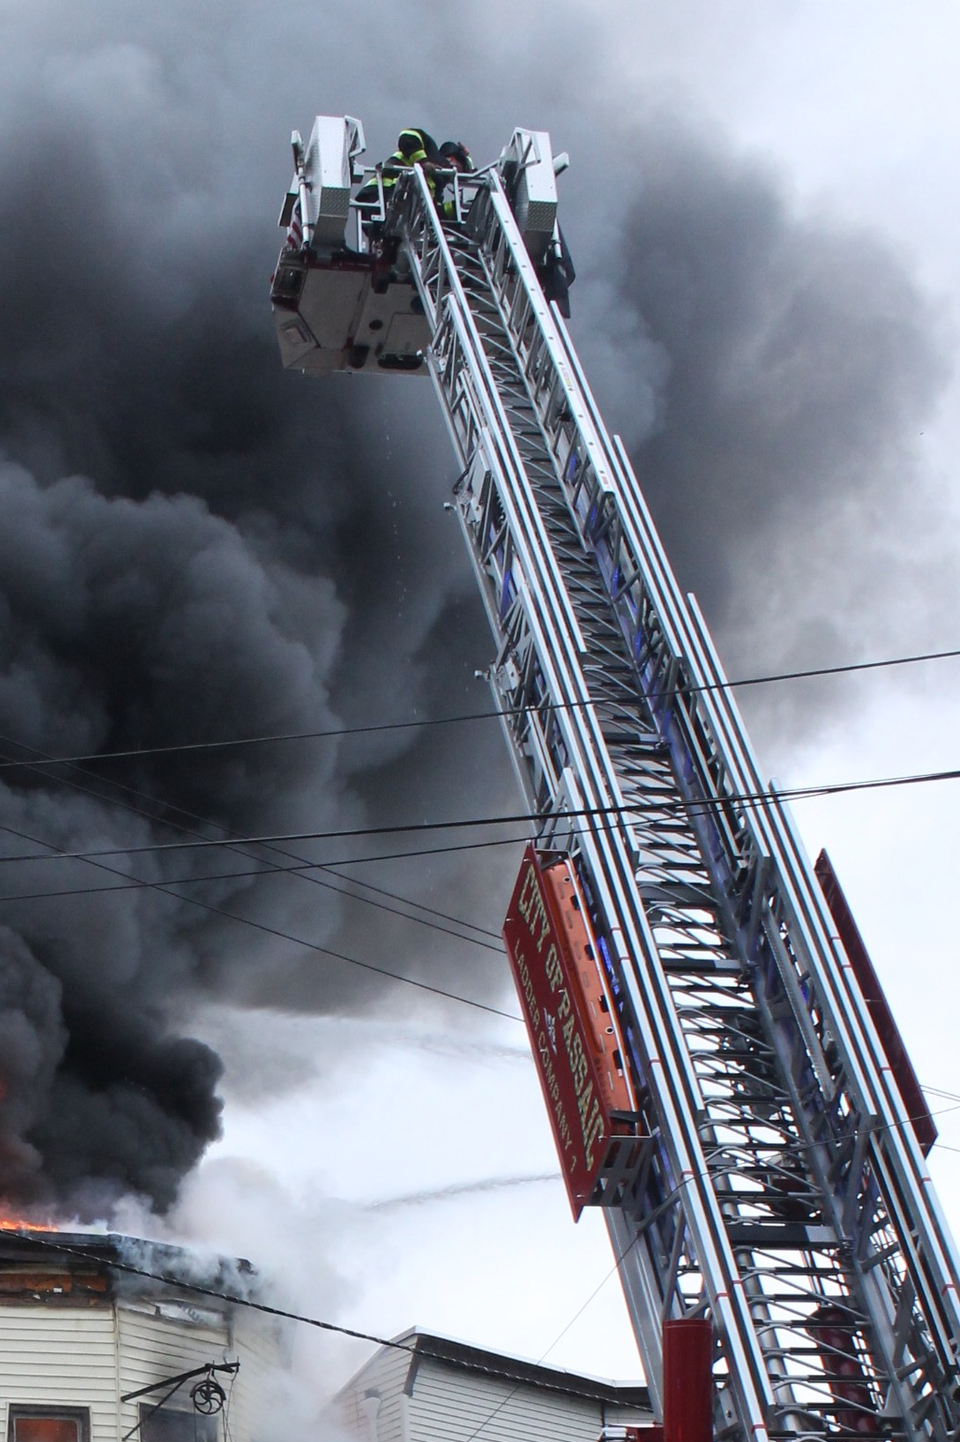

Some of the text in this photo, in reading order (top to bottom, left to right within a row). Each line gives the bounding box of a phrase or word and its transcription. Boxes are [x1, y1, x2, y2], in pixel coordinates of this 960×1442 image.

[514, 938, 540, 1031] LADDER
[538, 1031, 573, 1150] COMPANY
[518, 864, 551, 953] CITY
[545, 943, 564, 994] OF
[557, 987, 604, 1172] PASSAIC
